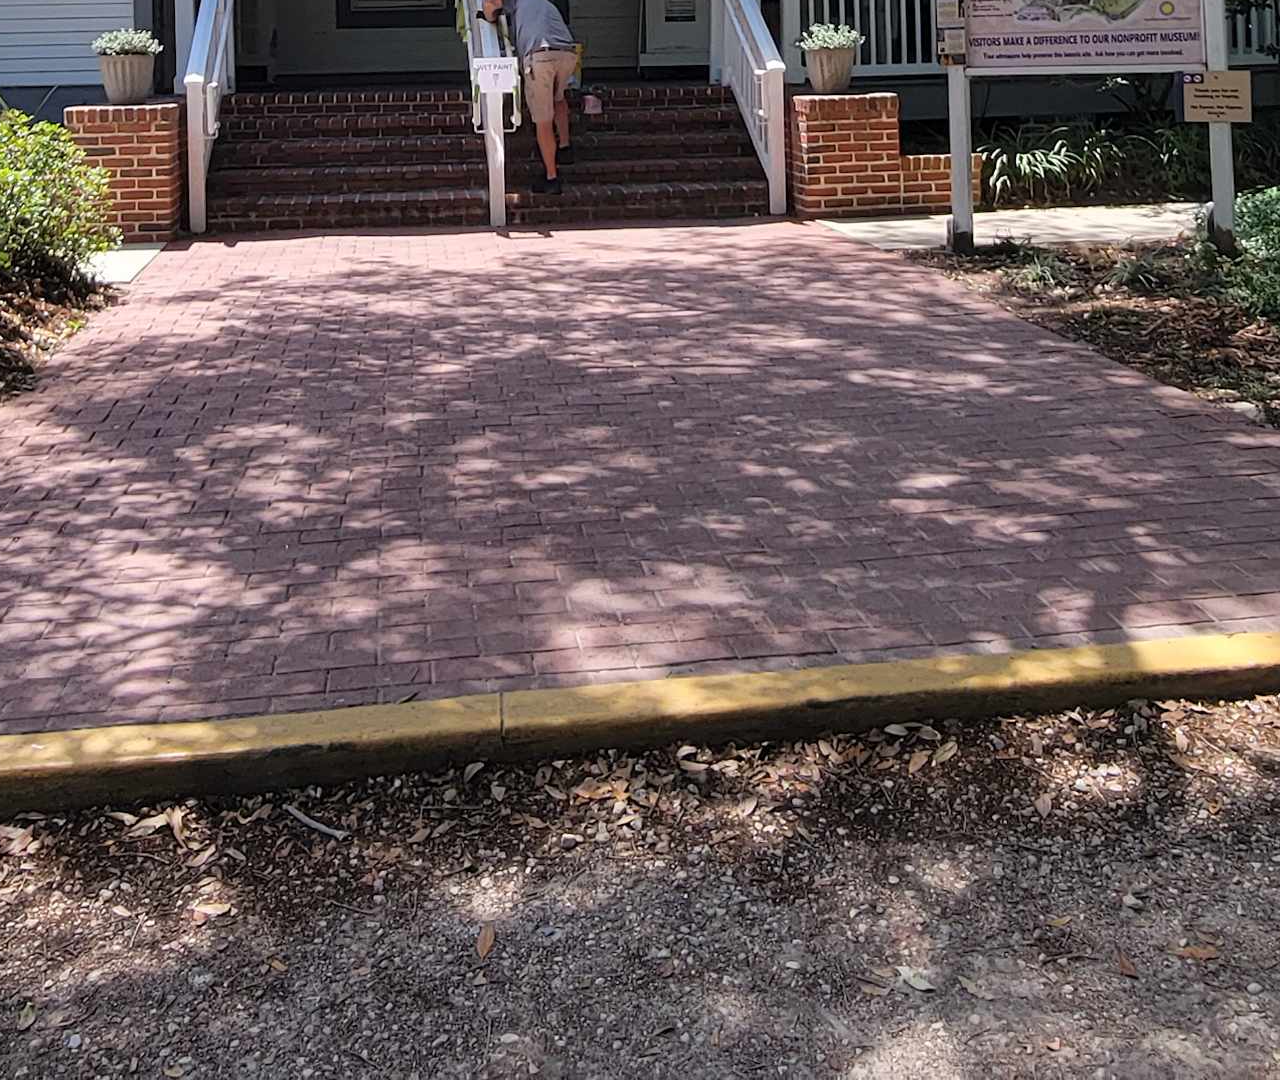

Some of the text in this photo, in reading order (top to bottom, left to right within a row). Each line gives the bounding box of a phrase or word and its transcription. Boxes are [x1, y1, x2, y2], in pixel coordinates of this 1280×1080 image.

[968, 32, 1200, 47] VISITORS MAKE A DIFFERENCE TO OUR NONPROFIT MUSEUM!
[478, 63, 513, 71] WET PAINT
